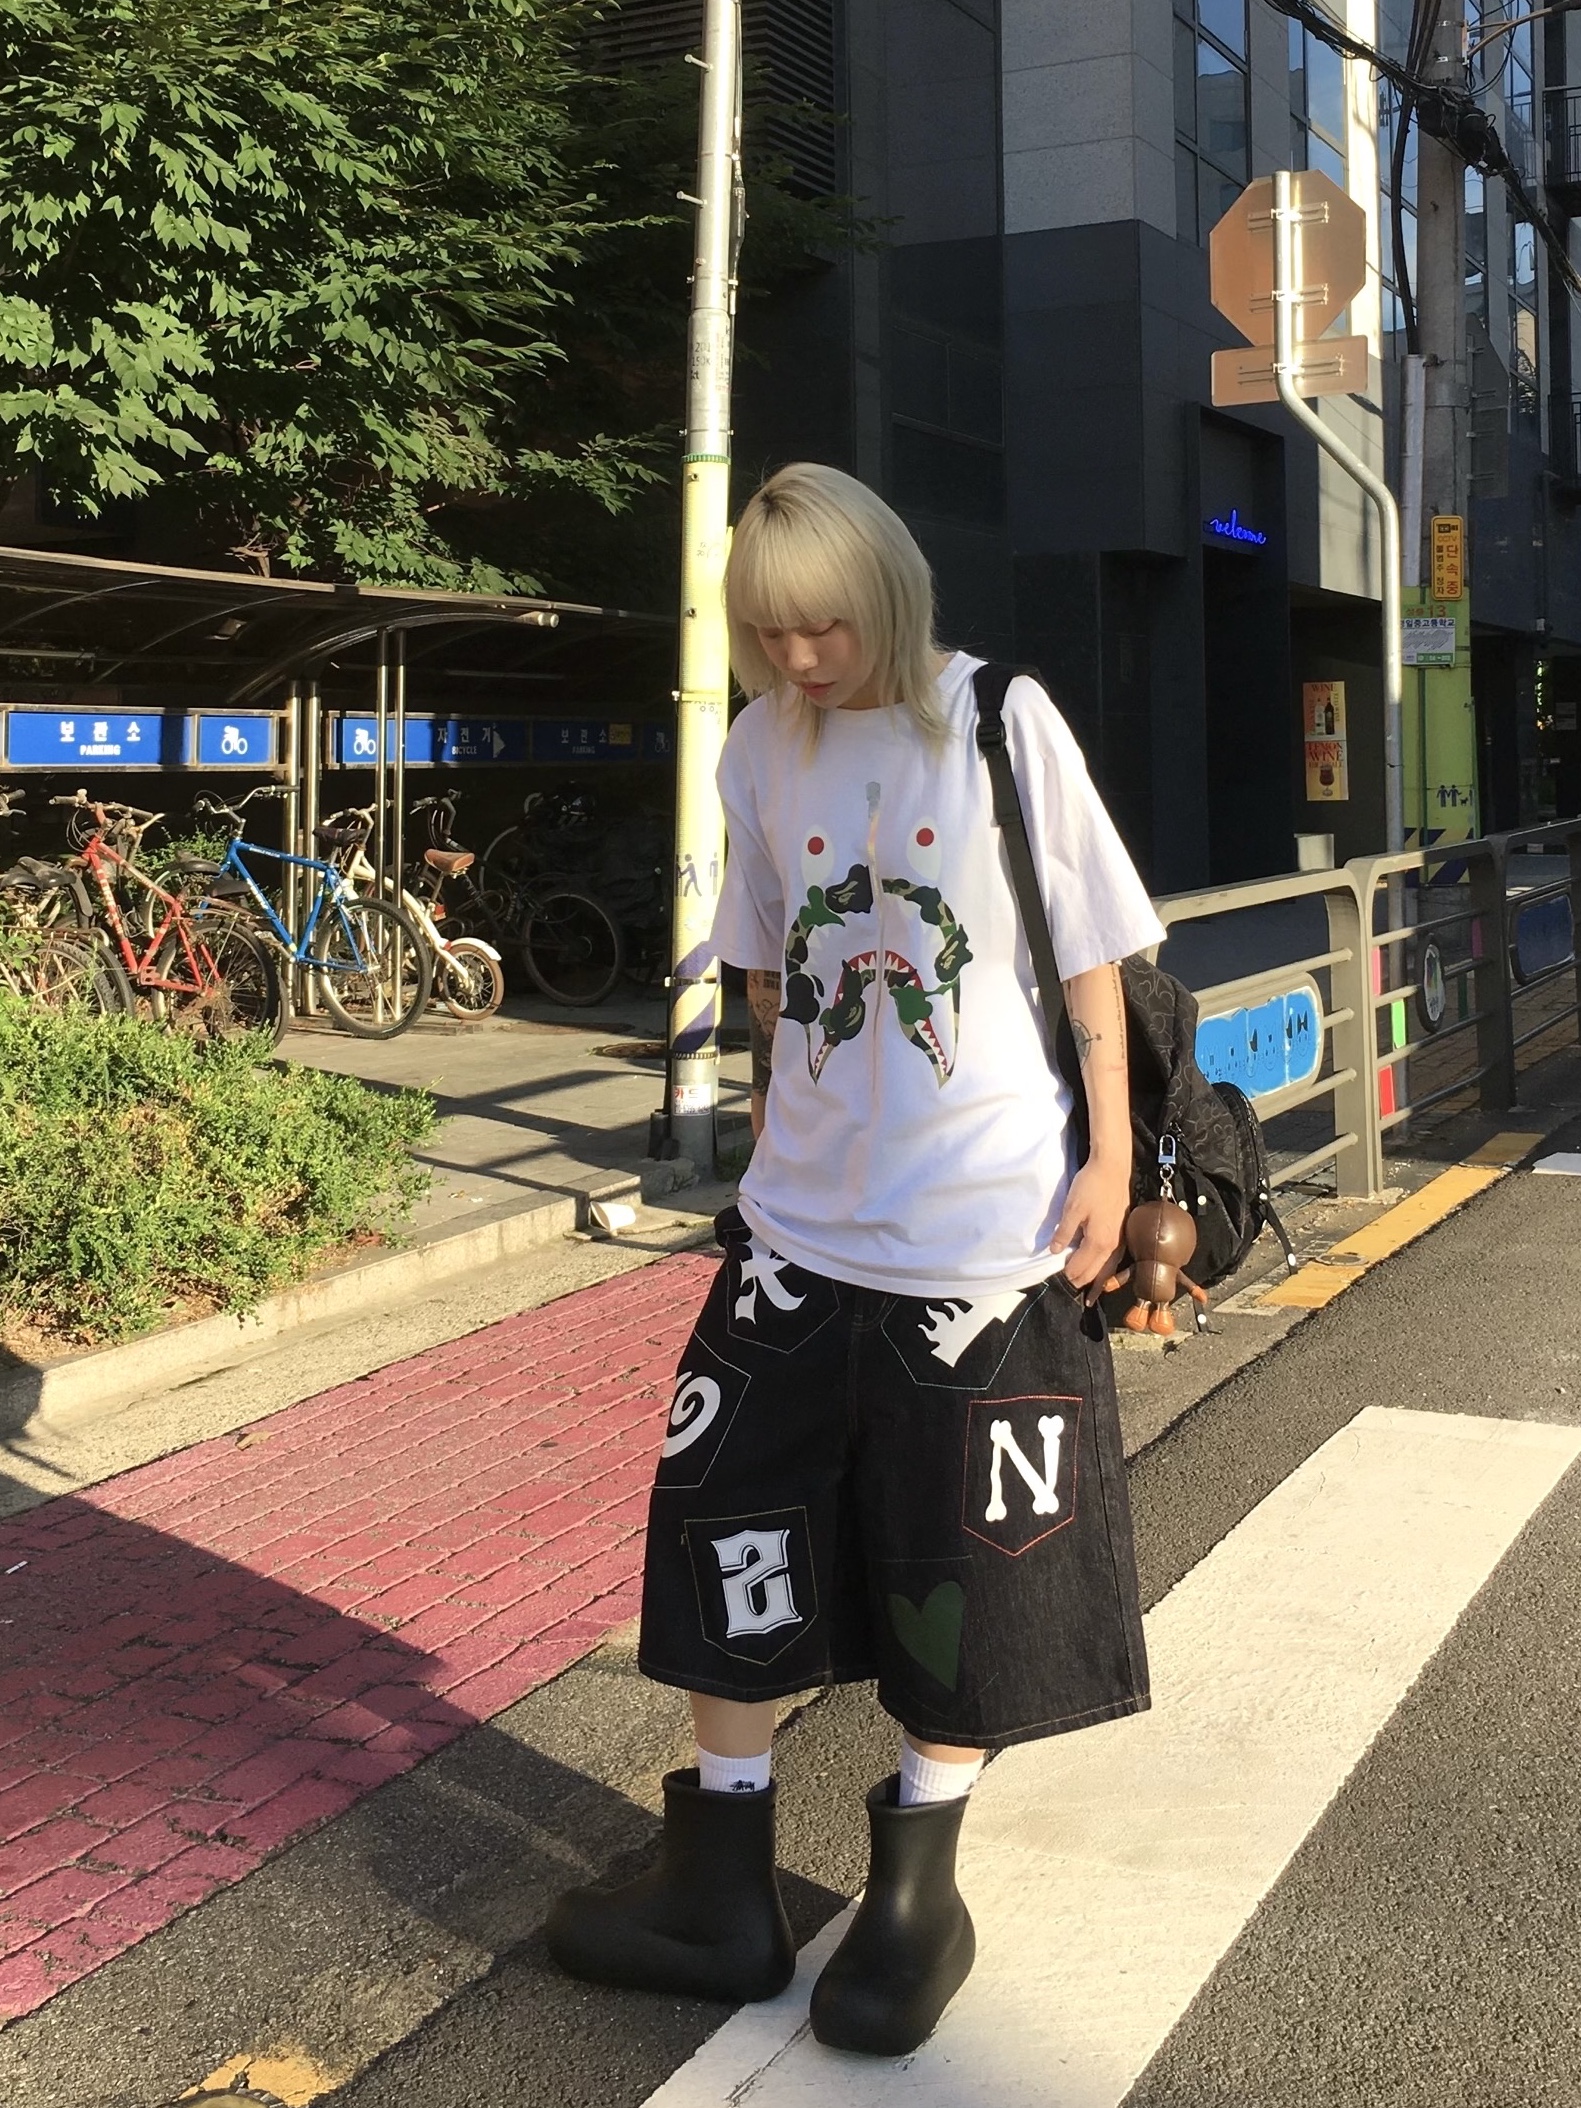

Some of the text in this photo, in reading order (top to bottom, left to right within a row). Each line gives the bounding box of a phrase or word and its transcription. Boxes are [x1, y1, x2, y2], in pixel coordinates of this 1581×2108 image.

[1210, 509, 1267, 544] welcome
[1437, 535, 1458, 543] CCTV
[1446, 544, 1459, 595] 단속중
[1429, 604, 1446, 618] 13
[1311, 683, 1336, 692] WINE
[60, 721, 141, 742] 보관소
[437, 727, 491, 743] 자전거
[561, 728, 607, 744] 보관소
[80, 744, 121, 756] PARKING
[451, 745, 478, 755] BICYCLE
[1308, 742, 1343, 751] LEMON
[1309, 750, 1344, 761] WINE
[710, 1529, 803, 1639] 2
